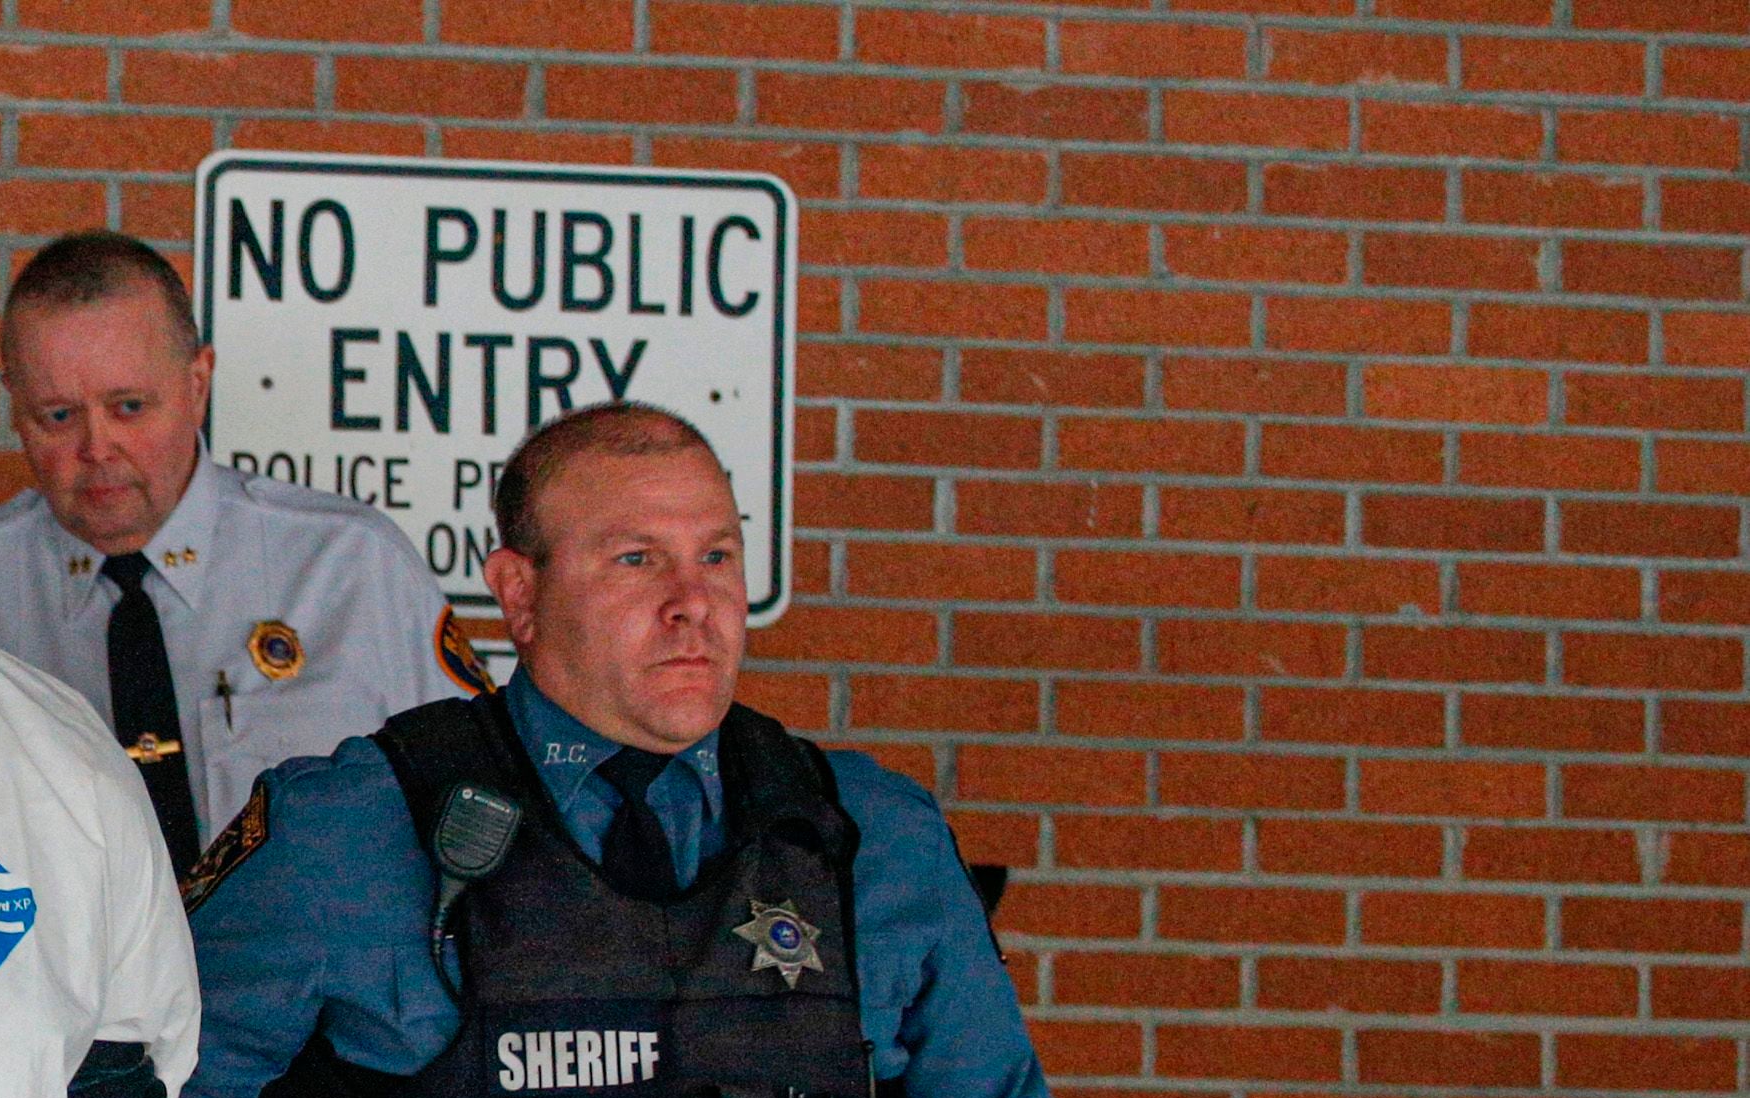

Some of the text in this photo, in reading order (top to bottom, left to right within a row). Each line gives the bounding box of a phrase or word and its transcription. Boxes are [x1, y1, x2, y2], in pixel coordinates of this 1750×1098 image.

[228, 198, 762, 318] NO PUBLIC
[330, 327, 648, 436] ENTRY
[13, 898, 31, 911] XP
[497, 1030, 659, 1091] SHERIFF
